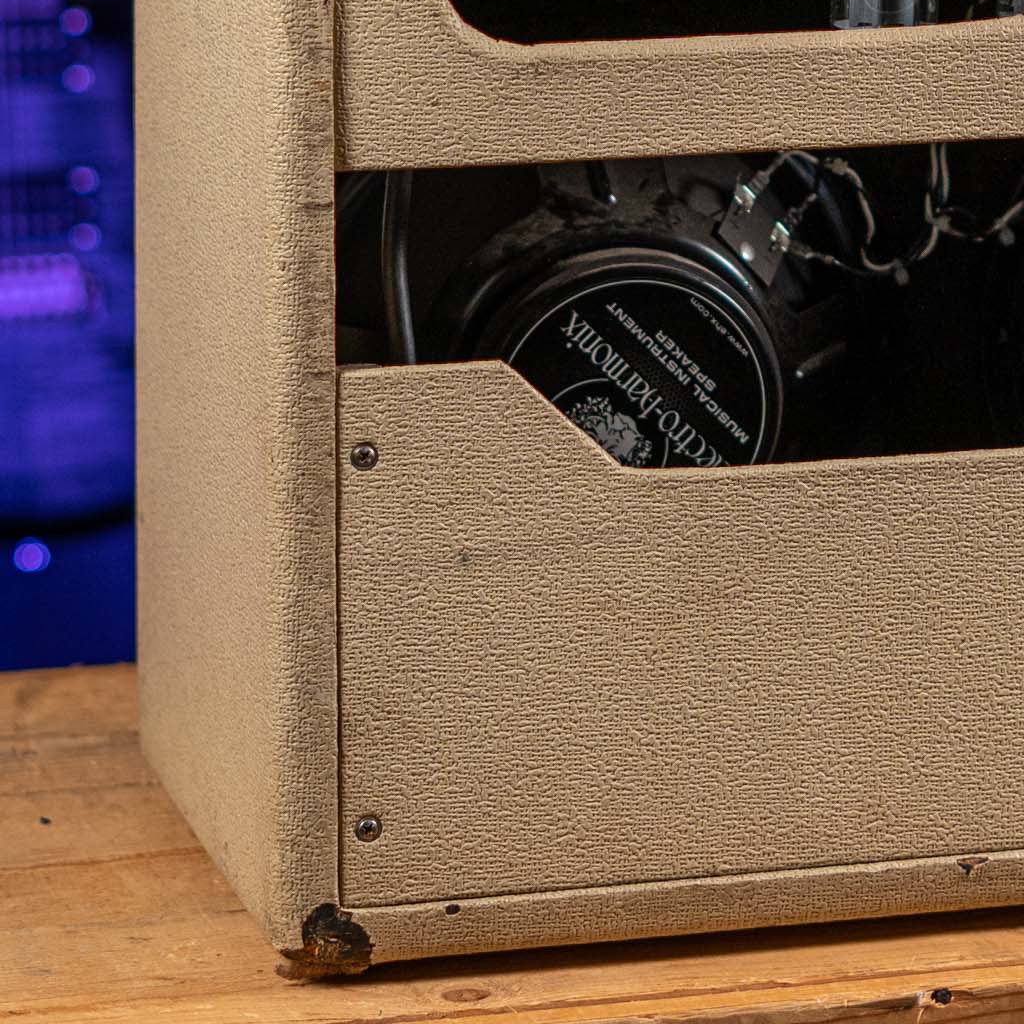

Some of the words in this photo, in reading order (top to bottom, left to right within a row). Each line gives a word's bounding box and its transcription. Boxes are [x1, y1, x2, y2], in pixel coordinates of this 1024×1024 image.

[605, 302, 692, 387] INSTRUMENT
[690, 297, 750, 358] www.ehx.com
[560, 310, 730, 467] ectro-harmonix
[655, 329, 717, 392] SPEAKER
[691, 384, 750, 444] MUSICAL
